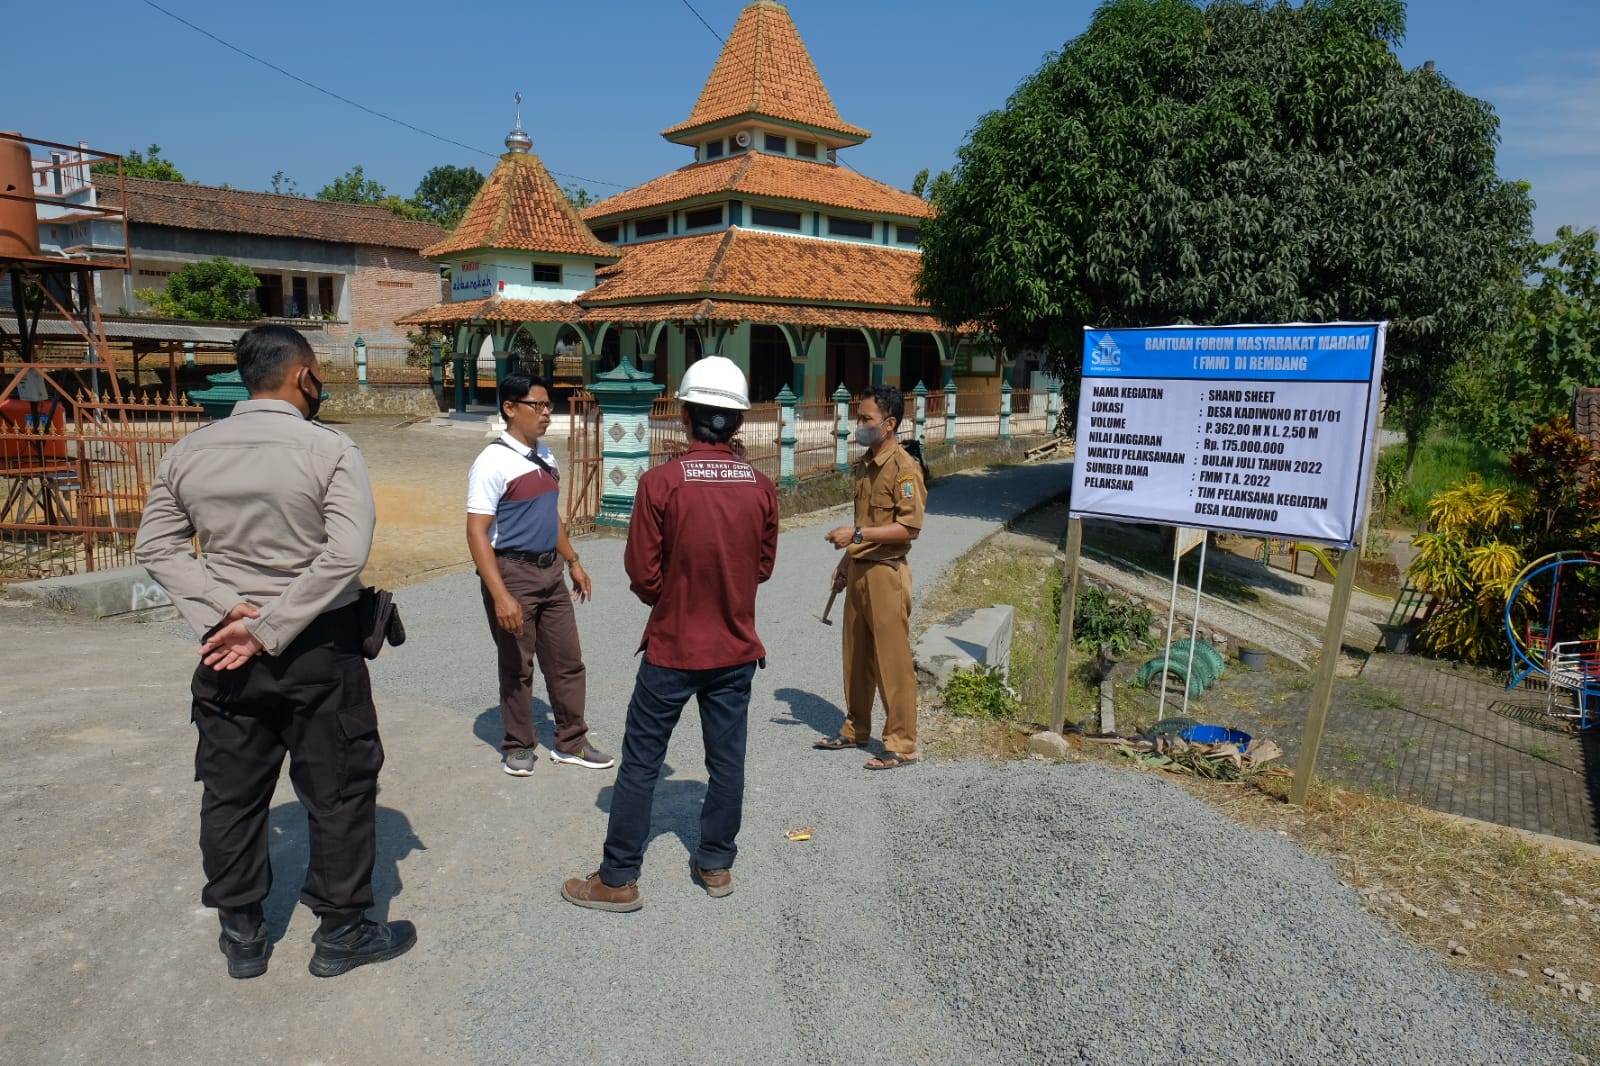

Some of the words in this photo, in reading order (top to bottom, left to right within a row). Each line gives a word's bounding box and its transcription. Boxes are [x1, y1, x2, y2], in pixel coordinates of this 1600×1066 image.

[1145, 337, 1194, 350] BANTUAN
[1195, 337, 1234, 350] FORUM
[1237, 336, 1316, 350] MASYARAKAT
[1318, 335, 1370, 350] MADANI
[1234, 356, 1247, 370] DI
[1249, 356, 1308, 371] REMBANG
[1093, 386, 1119, 398] NAMA
[1120, 387, 1164, 400] KEGIATAN
[1208, 390, 1242, 402] SHAND
[1244, 391, 1276, 403] SHEET
[1091, 401, 1124, 413] LOKASI
[1207, 406, 1232, 418] DESA
[1234, 407, 1291, 421] KADIWONO
[1293, 409, 1308, 421] RT
[1308, 410, 1342, 423] 01/01
[1090, 416, 1127, 429] VOLUME
[1214, 422, 1250, 436] 362,00
[1252, 425, 1262, 436] M
[1263, 425, 1271, 436] X
[1282, 426, 1306, 439] 2,50
[1308, 427, 1319, 439] M
[1088, 431, 1113, 443] NILAI
[1113, 433, 1163, 447] ANGGARAN
[1203, 438, 1219, 451] Rp.
[1222, 439, 1285, 454] 175.000.000
[1087, 446, 1120, 459] WAKTU
[1121, 448, 1185, 464] PELAKSANAAN
[1201, 454, 1234, 468] BULAN
[1235, 456, 1255, 469] JULI
[1257, 458, 1292, 472] TAHUN
[1293, 460, 1323, 474] 2022
[686, 469, 718, 478] SEMEN
[720, 470, 753, 479] GRESIK
[1086, 461, 1123, 475] SUMBER
[1124, 464, 1149, 477] DANA
[1199, 470, 1223, 483] FMM
[1243, 474, 1271, 487] 2022
[1084, 476, 1134, 491] PELAKSANA
[1197, 486, 1216, 499] TIM
[1217, 488, 1275, 504] PELAKSANA
[1276, 493, 1328, 510] KEGIATAN
[1194, 502, 1220, 516] DESA
[1221, 504, 1278, 522] KADIWONO
